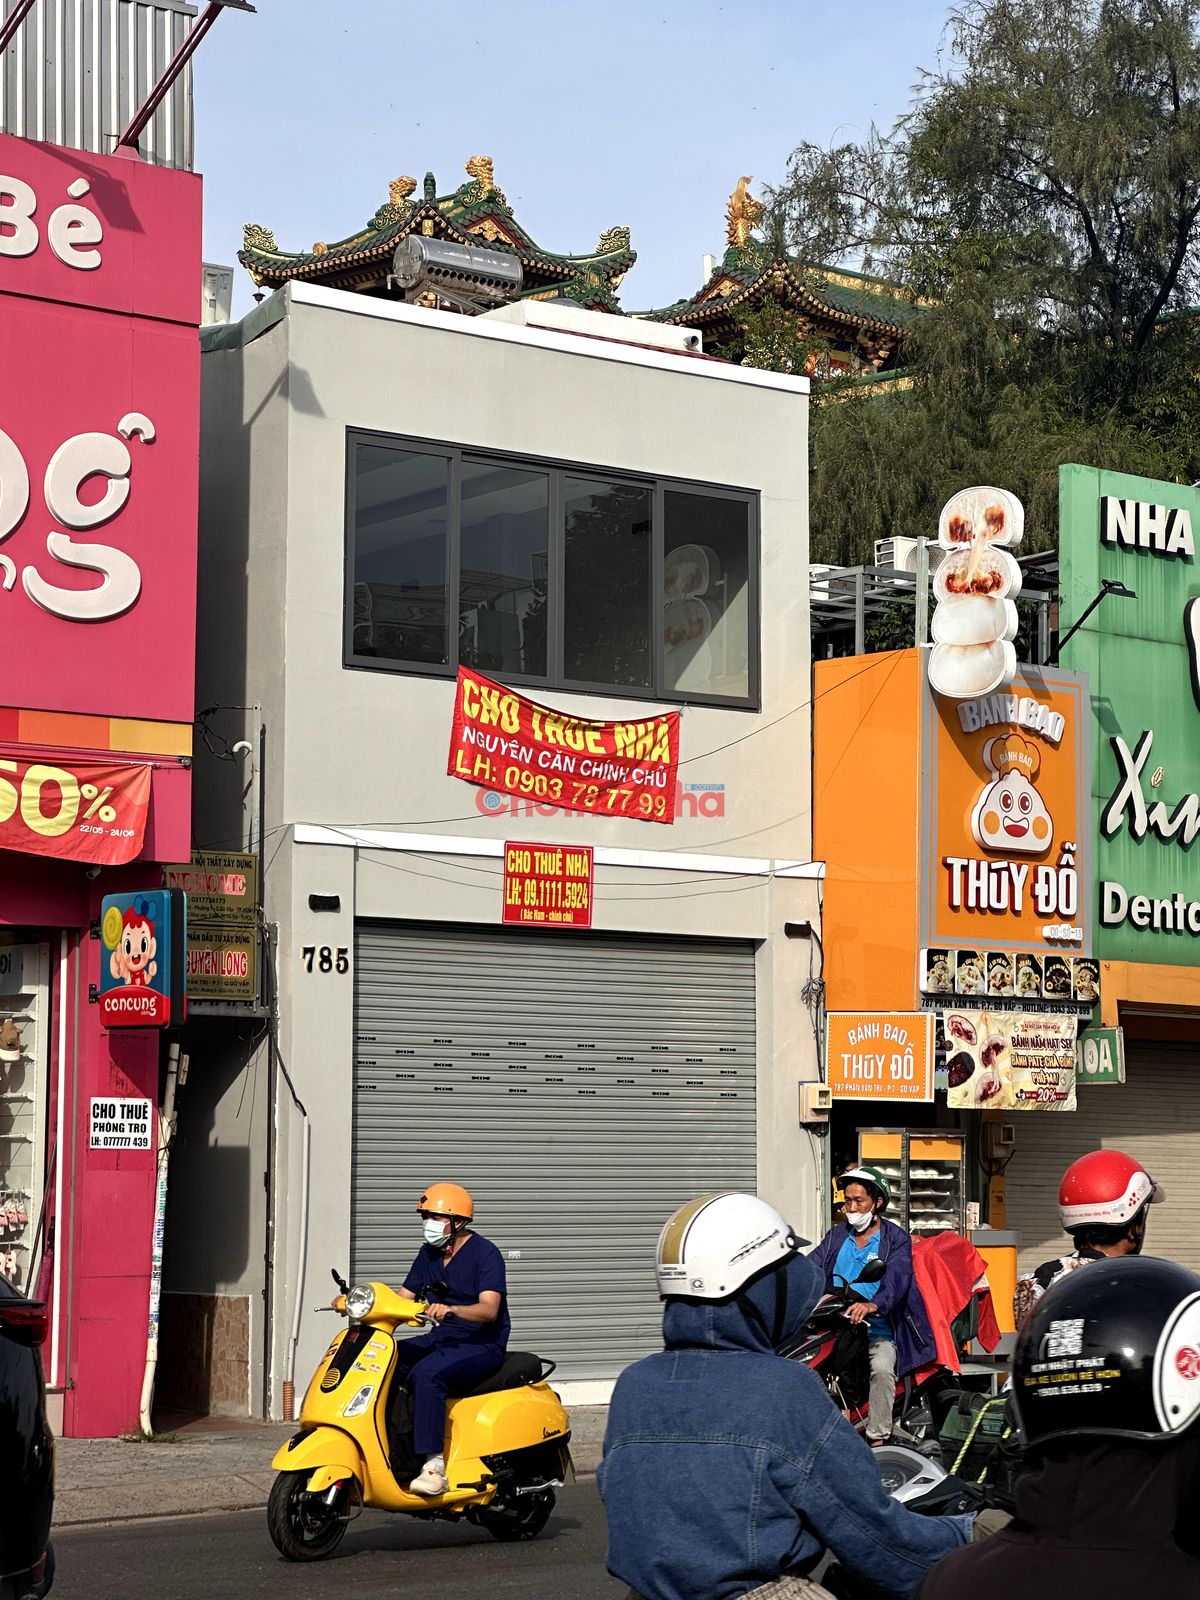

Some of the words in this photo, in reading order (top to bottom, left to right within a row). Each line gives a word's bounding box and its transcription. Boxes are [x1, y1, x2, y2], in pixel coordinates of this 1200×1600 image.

[0, 176, 103, 272] Bé
[1101, 496, 1196, 555] NHA
[462, 678, 521, 734] CHO
[462, 725, 534, 764] NGUYÊN
[538, 750, 576, 774] CĂN
[580, 759, 630, 784] CHÍNH
[632, 765, 668, 789] CHỦ
[455, 749, 497, 783] LH:
[504, 766, 564, 800] 0903
[606, 788, 634, 811] 77
[639, 792, 667, 817] 99
[507, 849, 531, 874] CHO
[533, 848, 563, 876] THUÊ
[565, 850, 589, 878] NHÀ
[506, 877, 522, 906] LH:
[523, 878, 589, 910] 09.1111.5924
[220, 950, 248, 978] LONG
[302, 946, 349, 975] 785
[847, 1021, 881, 1046] BÁNH
[882, 1023, 908, 1046] BAO
[889, 1041, 915, 1081] ĐỖ
[1036, 1086, 1057, 1103] 20%
[92, 1103, 116, 1120] CHO
[119, 1101, 149, 1120] THUÊ
[91, 1136, 102, 1146] LH:
[132, 1137, 148, 1147] 439
[92, 1121, 125, 1133] PHÒNG
[128, 1122, 147, 1136] TRỌ
